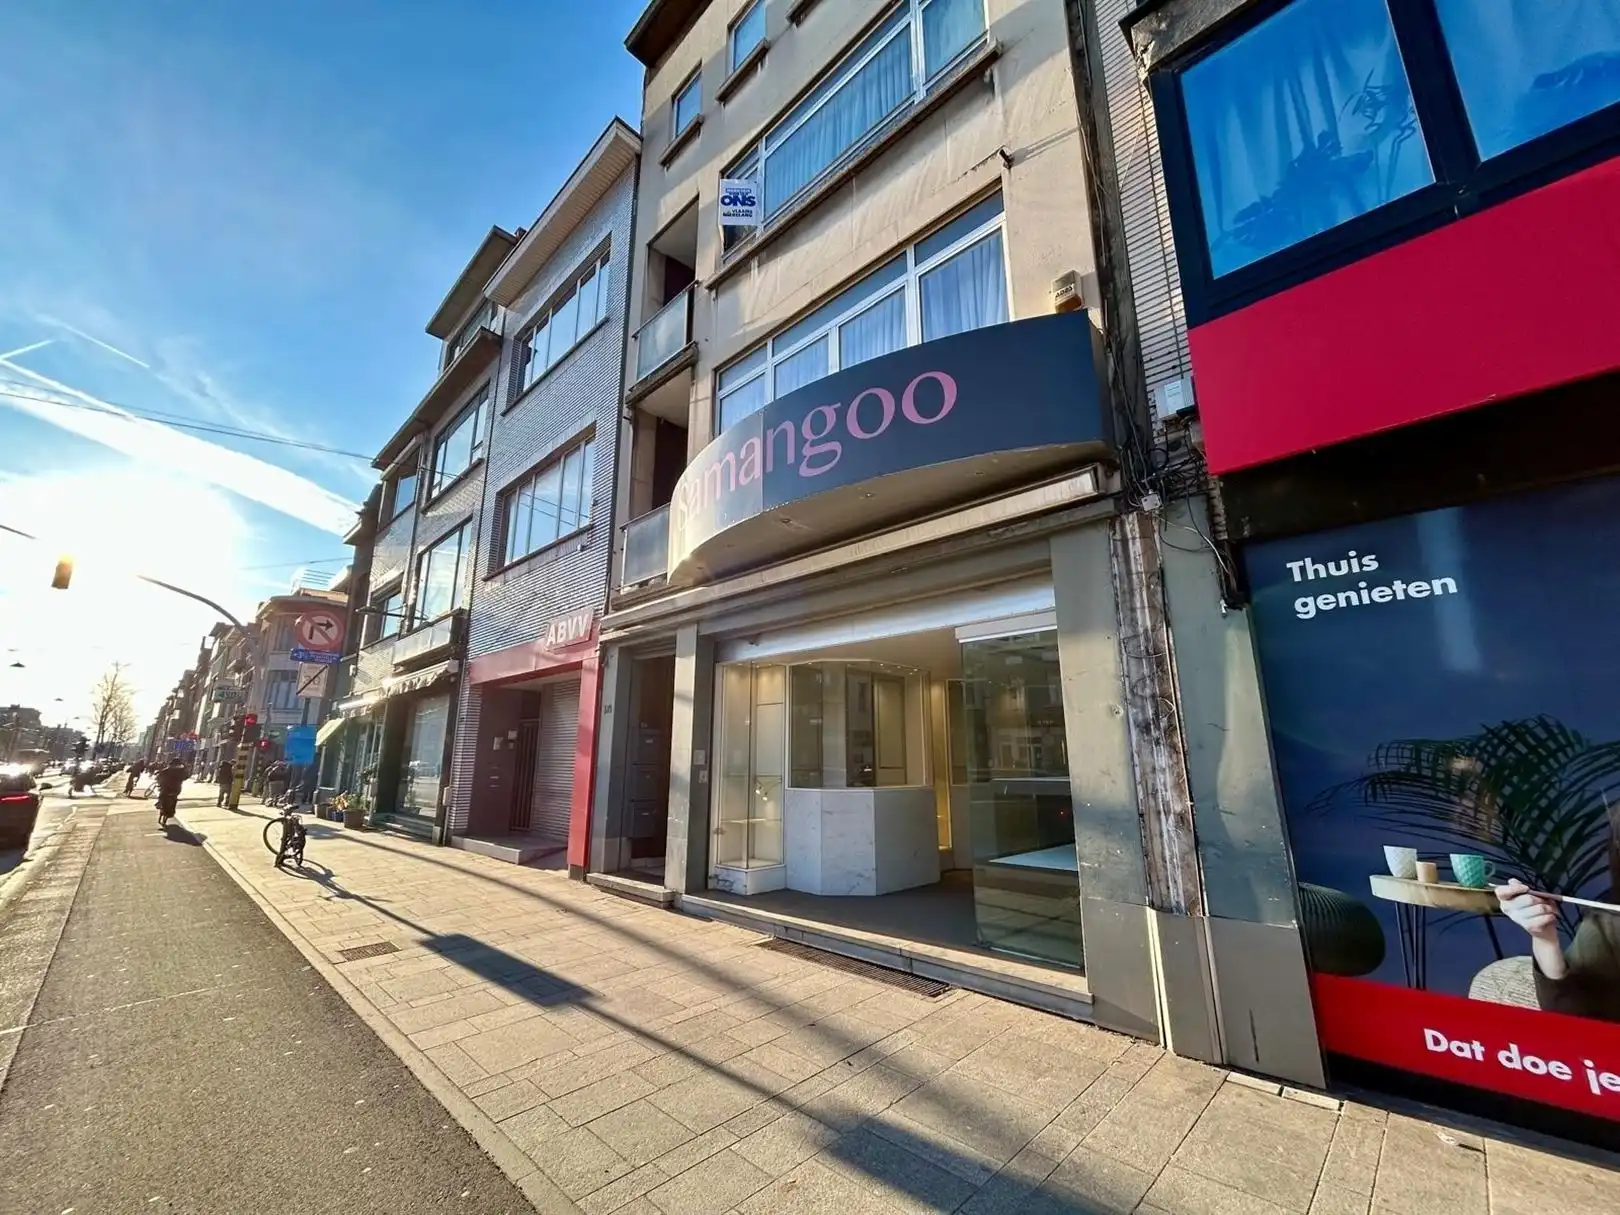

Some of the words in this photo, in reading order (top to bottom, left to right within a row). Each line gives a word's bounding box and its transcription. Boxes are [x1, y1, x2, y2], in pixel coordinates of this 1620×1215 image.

[721, 195, 756, 207] ONS
[1286, 550, 1379, 582] Thuis
[1294, 577, 1458, 620] genieten
[546, 614, 589, 646] ABVV
[1423, 1028, 1486, 1061] Dat
[1497, 1042, 1572, 1081] doe
[1583, 1059, 1620, 1095] je
